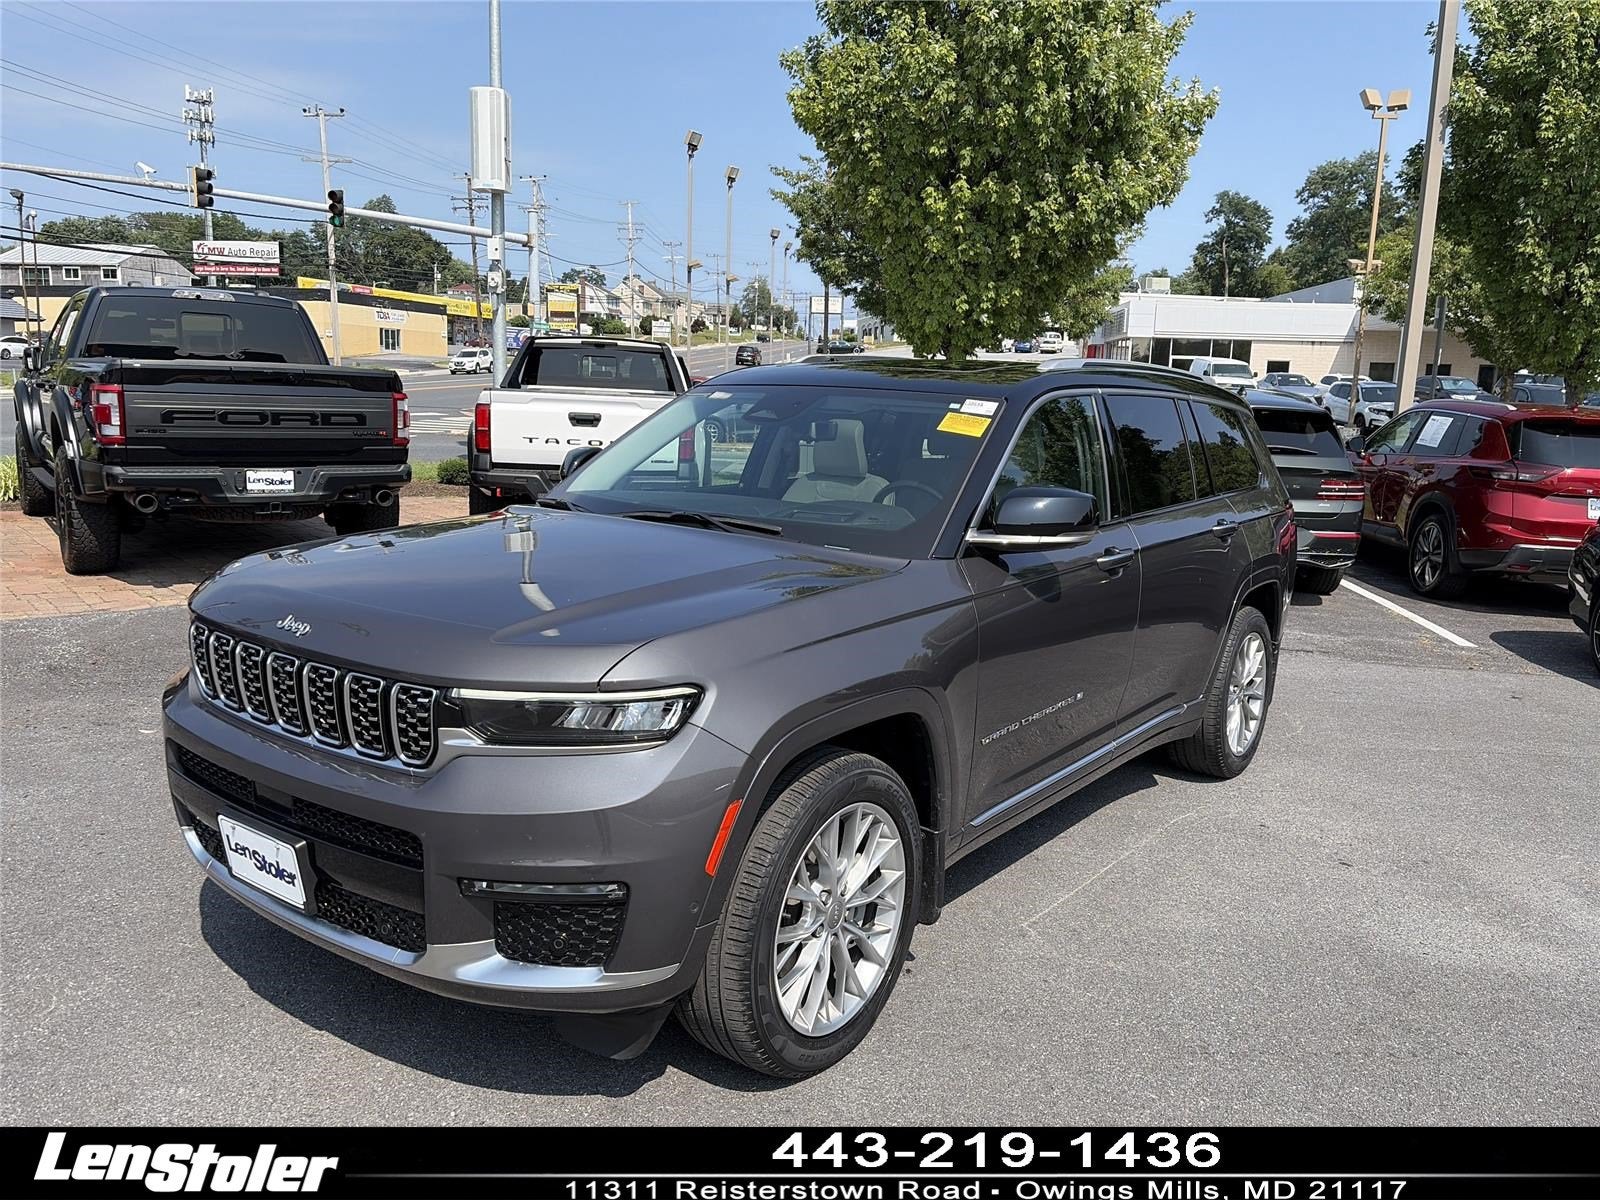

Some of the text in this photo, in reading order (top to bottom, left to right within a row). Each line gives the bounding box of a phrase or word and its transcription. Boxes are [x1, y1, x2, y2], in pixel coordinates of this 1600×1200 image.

[227, 247, 247, 256] Auto
[249, 247, 277, 257] Repair
[160, 408, 367, 427] FORD
[522, 436, 616, 447] TACO
[276, 614, 311, 637] Jeep
[981, 696, 1075, 745] GRAND CHEROKEE
[226, 833, 297, 888] LenStoler
